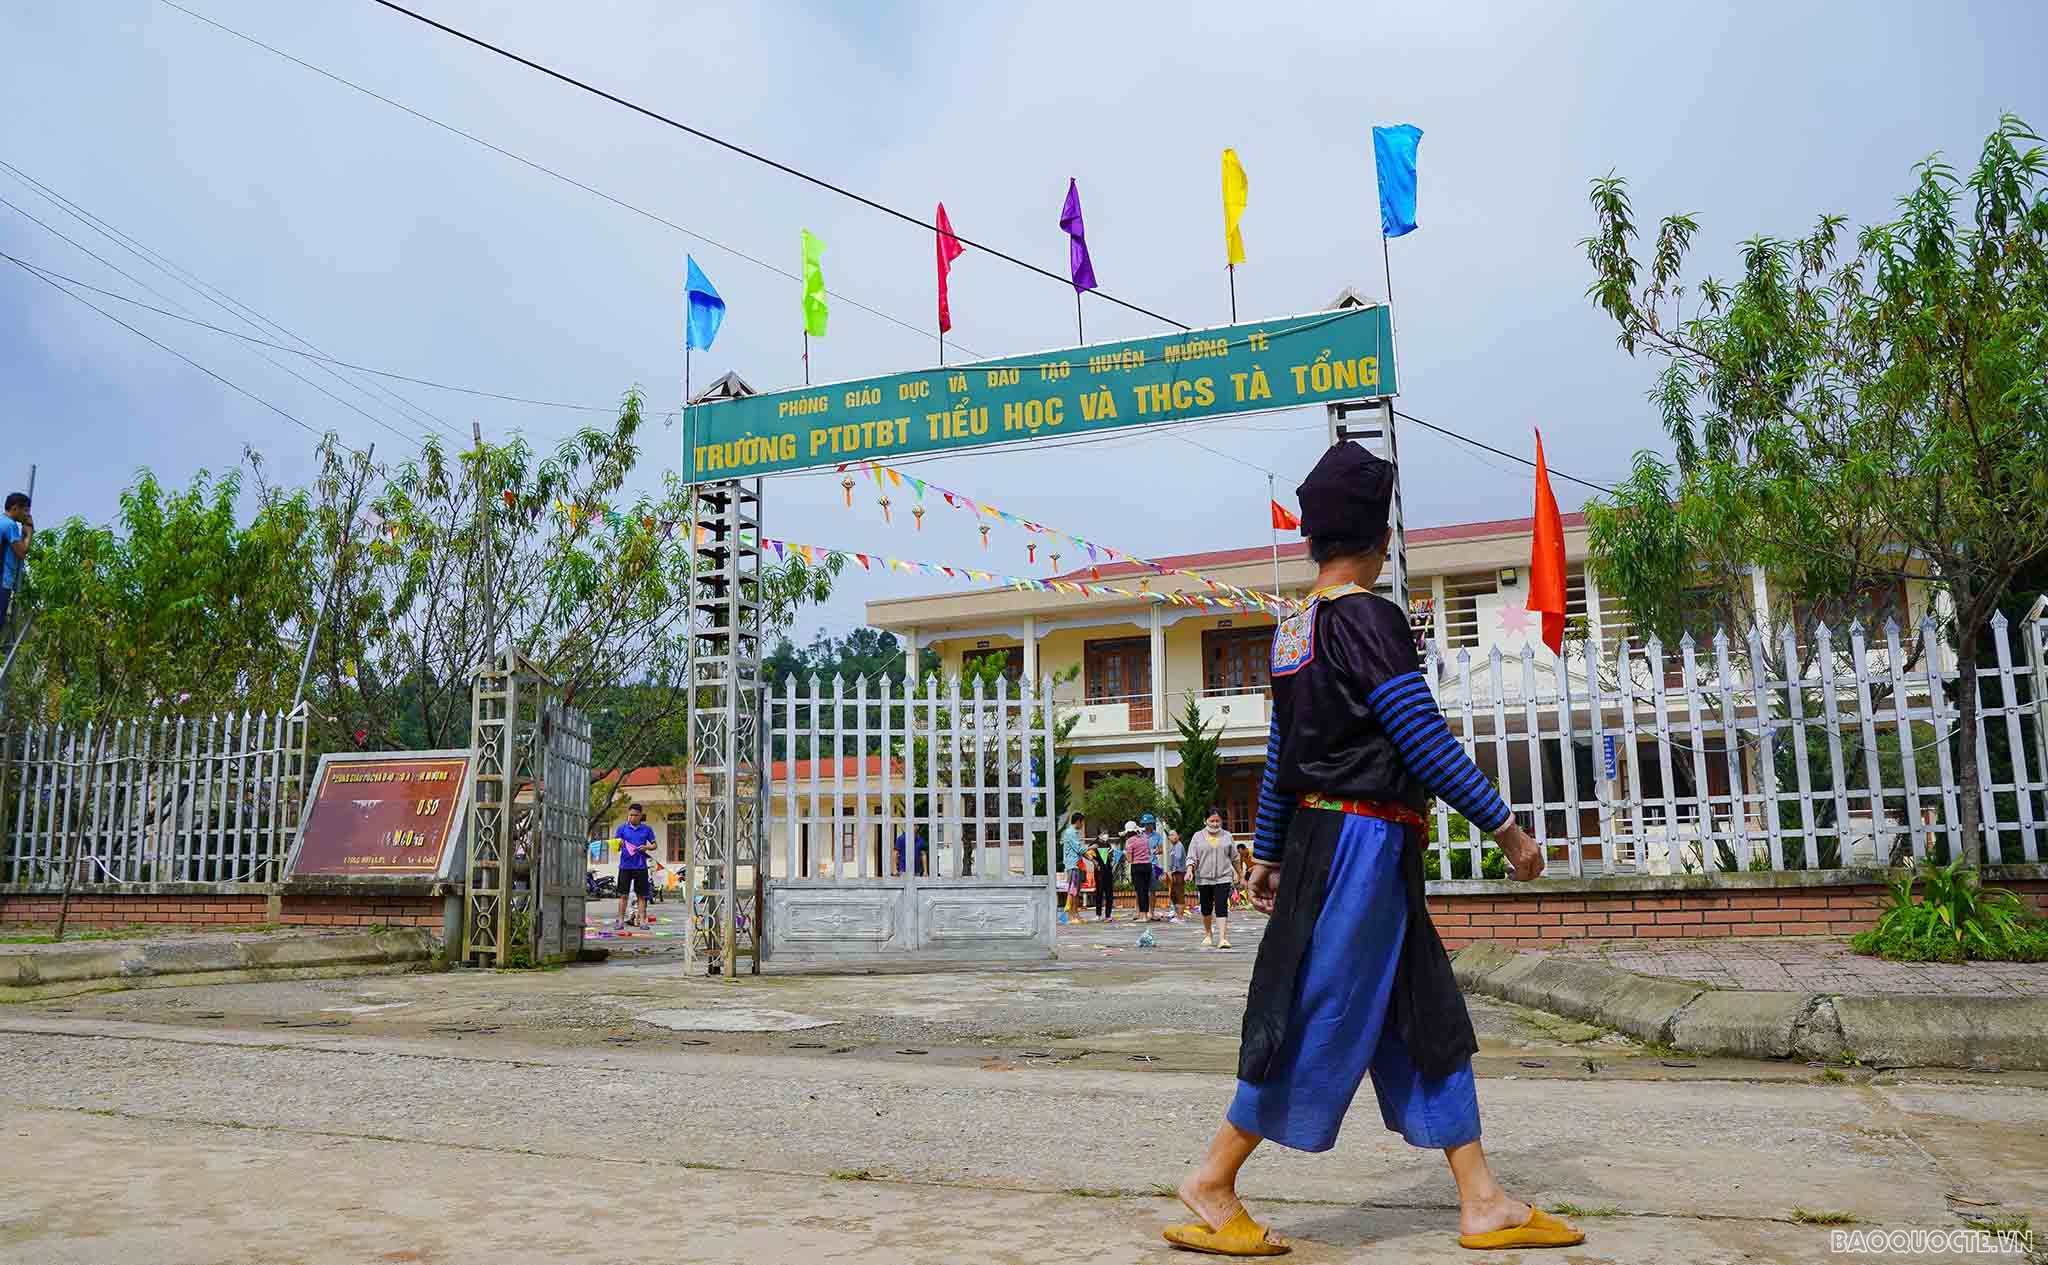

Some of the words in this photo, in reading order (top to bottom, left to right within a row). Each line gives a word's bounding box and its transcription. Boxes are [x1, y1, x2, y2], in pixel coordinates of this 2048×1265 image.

[694, 431, 796, 473] TRƯỜNG
[809, 417, 911, 457] PTDTBT
[926, 397, 989, 441] TIỂU
[1003, 397, 1064, 434] HỌC
[1079, 384, 1118, 422] VÀ
[1133, 377, 1216, 415] THCS
[1230, 364, 1273, 402] TÀ
[1290, 349, 1378, 394] TỔNG
[778, 394, 829, 418] PHÒNG
[845, 385, 881, 409] GIÁO
[948, 371, 969, 393] VÀ
[1040, 360, 1071, 383] TẠO
[1088, 348, 1145, 374] HUYỆN
